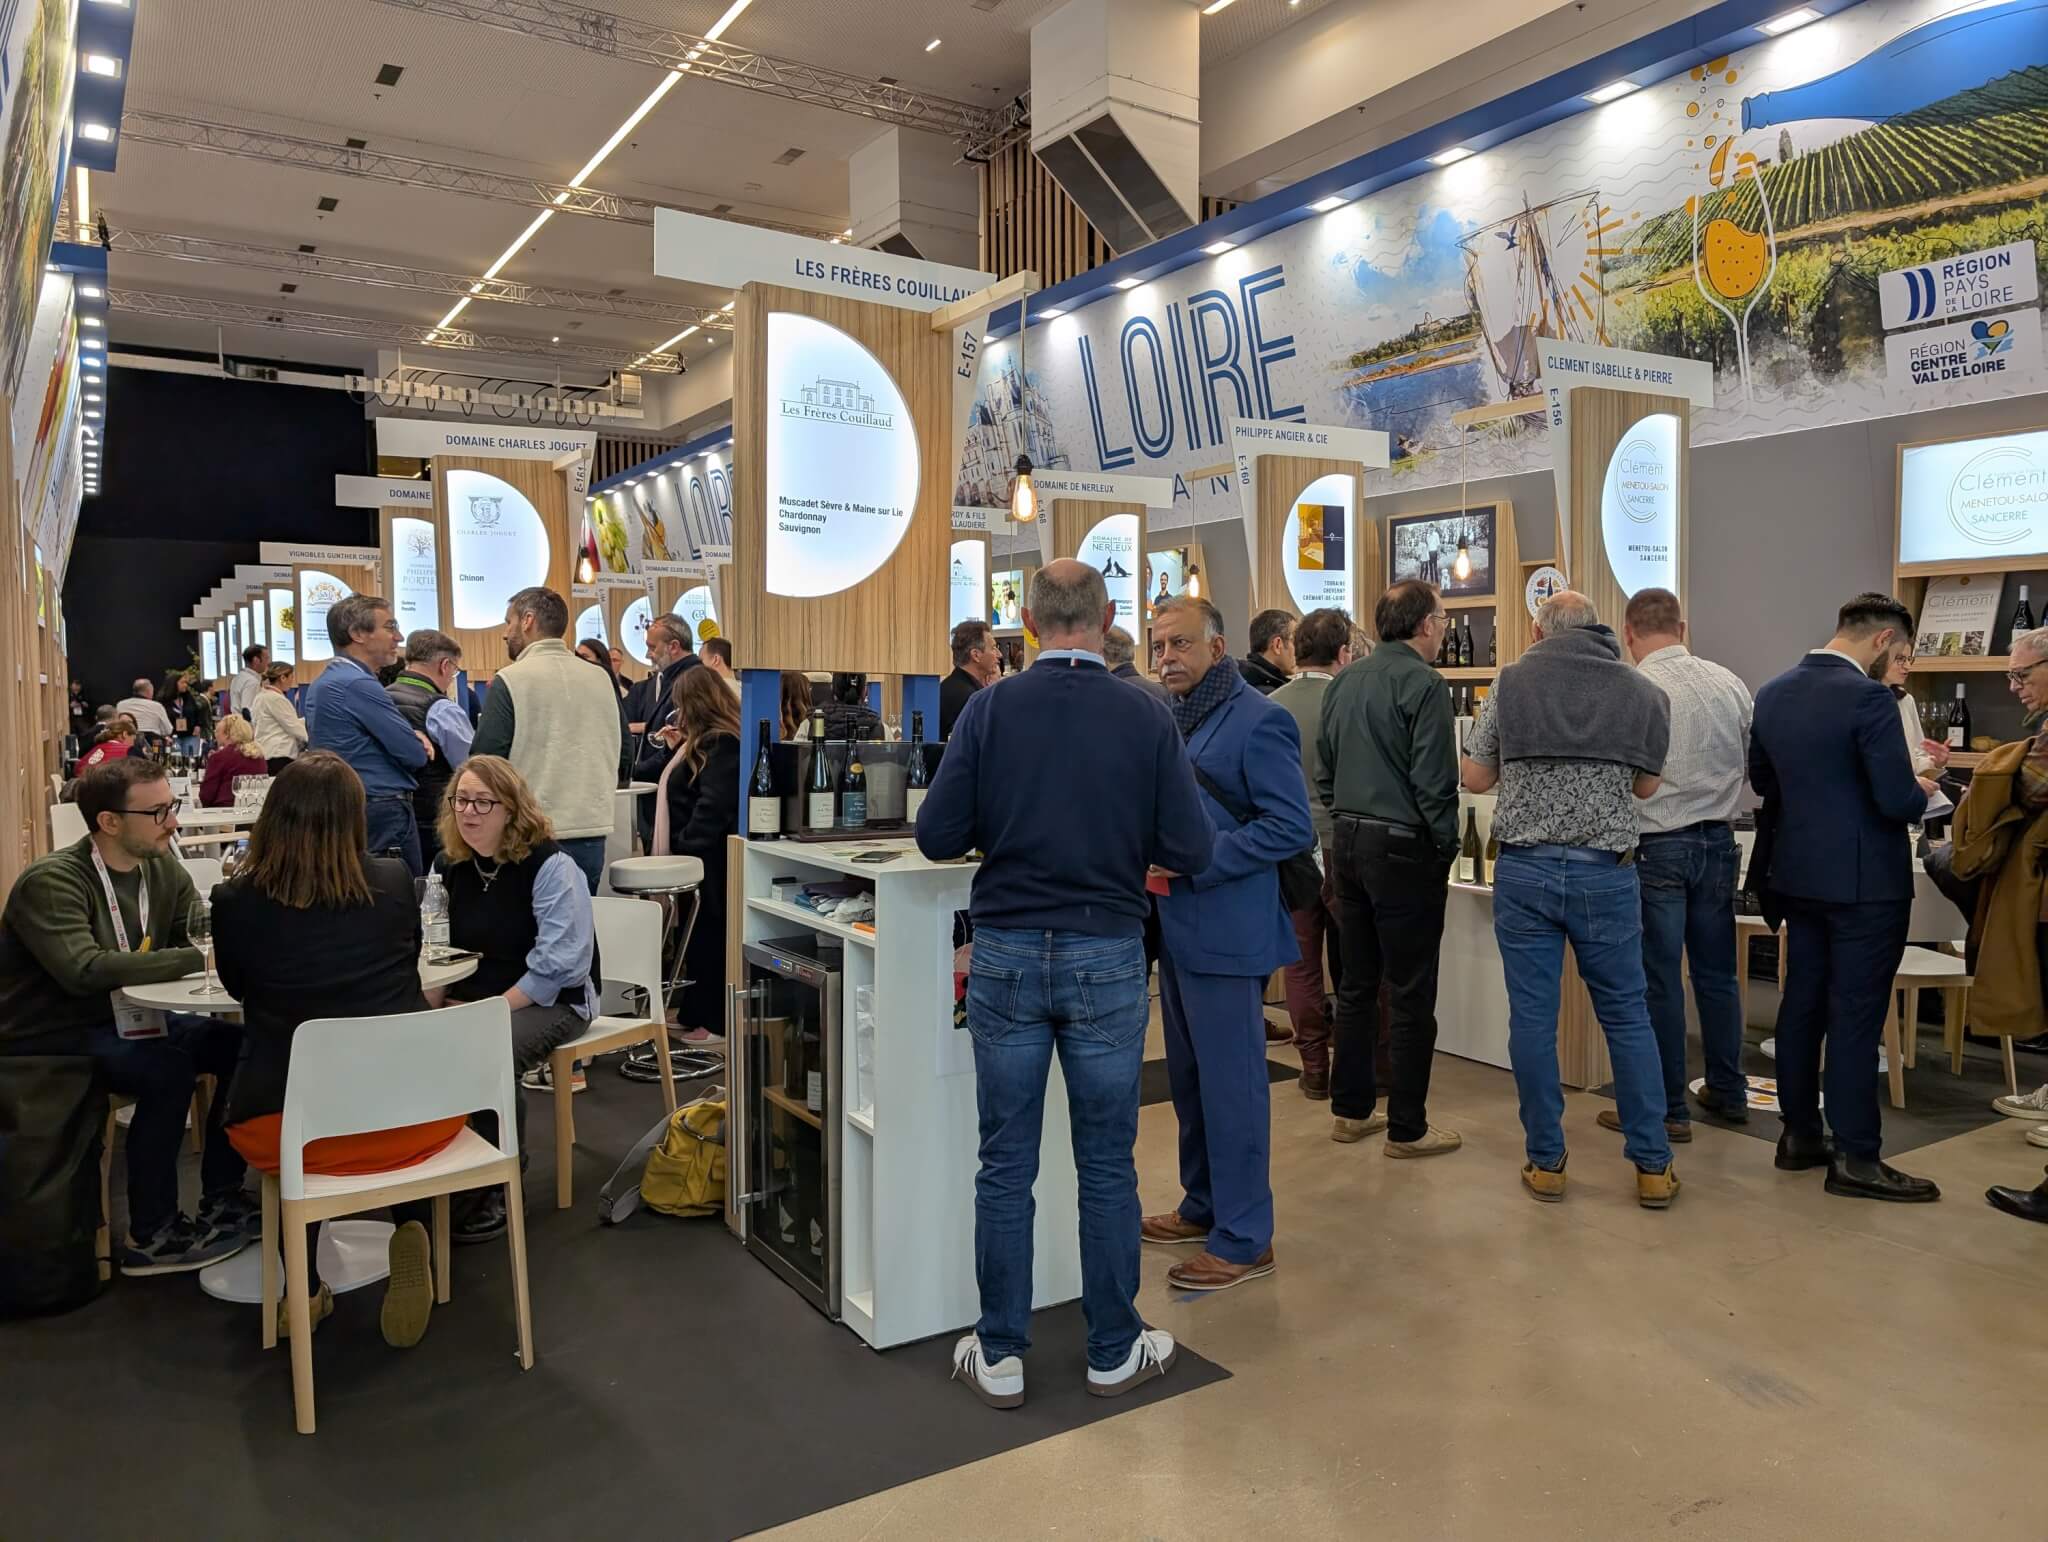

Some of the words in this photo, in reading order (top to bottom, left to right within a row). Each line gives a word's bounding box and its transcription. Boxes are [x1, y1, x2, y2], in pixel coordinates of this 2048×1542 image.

[795, 258, 825, 279] LES
[831, 264, 891, 291] FRÈRES
[1943, 251, 2011, 280] RÉGION
[1944, 273, 1990, 297] PAYS
[1945, 297, 1957, 306] DE
[1946, 306, 1958, 314] LA
[1961, 285, 2014, 311] LOIRE
[957, 331, 979, 379] E-157
[1910, 338, 1966, 360] RÉGION
[1078, 264, 1306, 471] LOIRE
[1547, 355, 1590, 374] CLEMENT
[1592, 362, 1633, 380] ISABELLE
[1634, 367, 1642, 380] &
[1643, 368, 1673, 385] PIERRE
[1911, 352, 1968, 372] CENTRE
[1912, 371, 1939, 385] VAL
[1941, 366, 1961, 381] DE
[1963, 358, 2006, 377] LOIRE
[782, 402, 801, 415] Les
[804, 405, 837, 420] Frères
[839, 410, 893, 427] Couillaud
[1550, 387, 1563, 427] E-156
[446, 434, 496, 448] DOMAINE
[498, 437, 546, 450] CHARLES
[1235, 426, 1273, 440] PHILIPPE
[1275, 430, 1306, 442] ANGIER
[1307, 432, 1314, 443] &
[1316, 433, 1328, 445] CIE
[1238, 455, 1250, 485] E-160
[1959, 468, 2047, 491] Clément
[389, 488, 431, 500] DOMAINE
[1033, 479, 1068, 491] DOMAINE
[1070, 481, 1081, 492] DE
[1081, 483, 1115, 493] NERLEUX
[779, 496, 819, 509] Muscadet
[820, 500, 843, 511] Sèvre
[844, 502, 851, 512] &
[852, 503, 876, 514] Maine
[878, 507, 890, 516] sur
[892, 507, 904, 517] Lie
[1961, 491, 2048, 509] MENETOU-SALO
[674, 464, 733, 561] LOIR
[779, 509, 827, 524] Chardonnay
[966, 511, 971, 519] &
[972, 512, 986, 520] FILS
[1970, 510, 2029, 524] SANCERRE
[778, 522, 822, 535] Sauvignon
[288, 550, 325, 559] VIGNOBLES
[327, 552, 358, 560] GUNTHER
[1092, 543, 1133, 552] NERLEUX
[459, 573, 485, 582] Chinon
